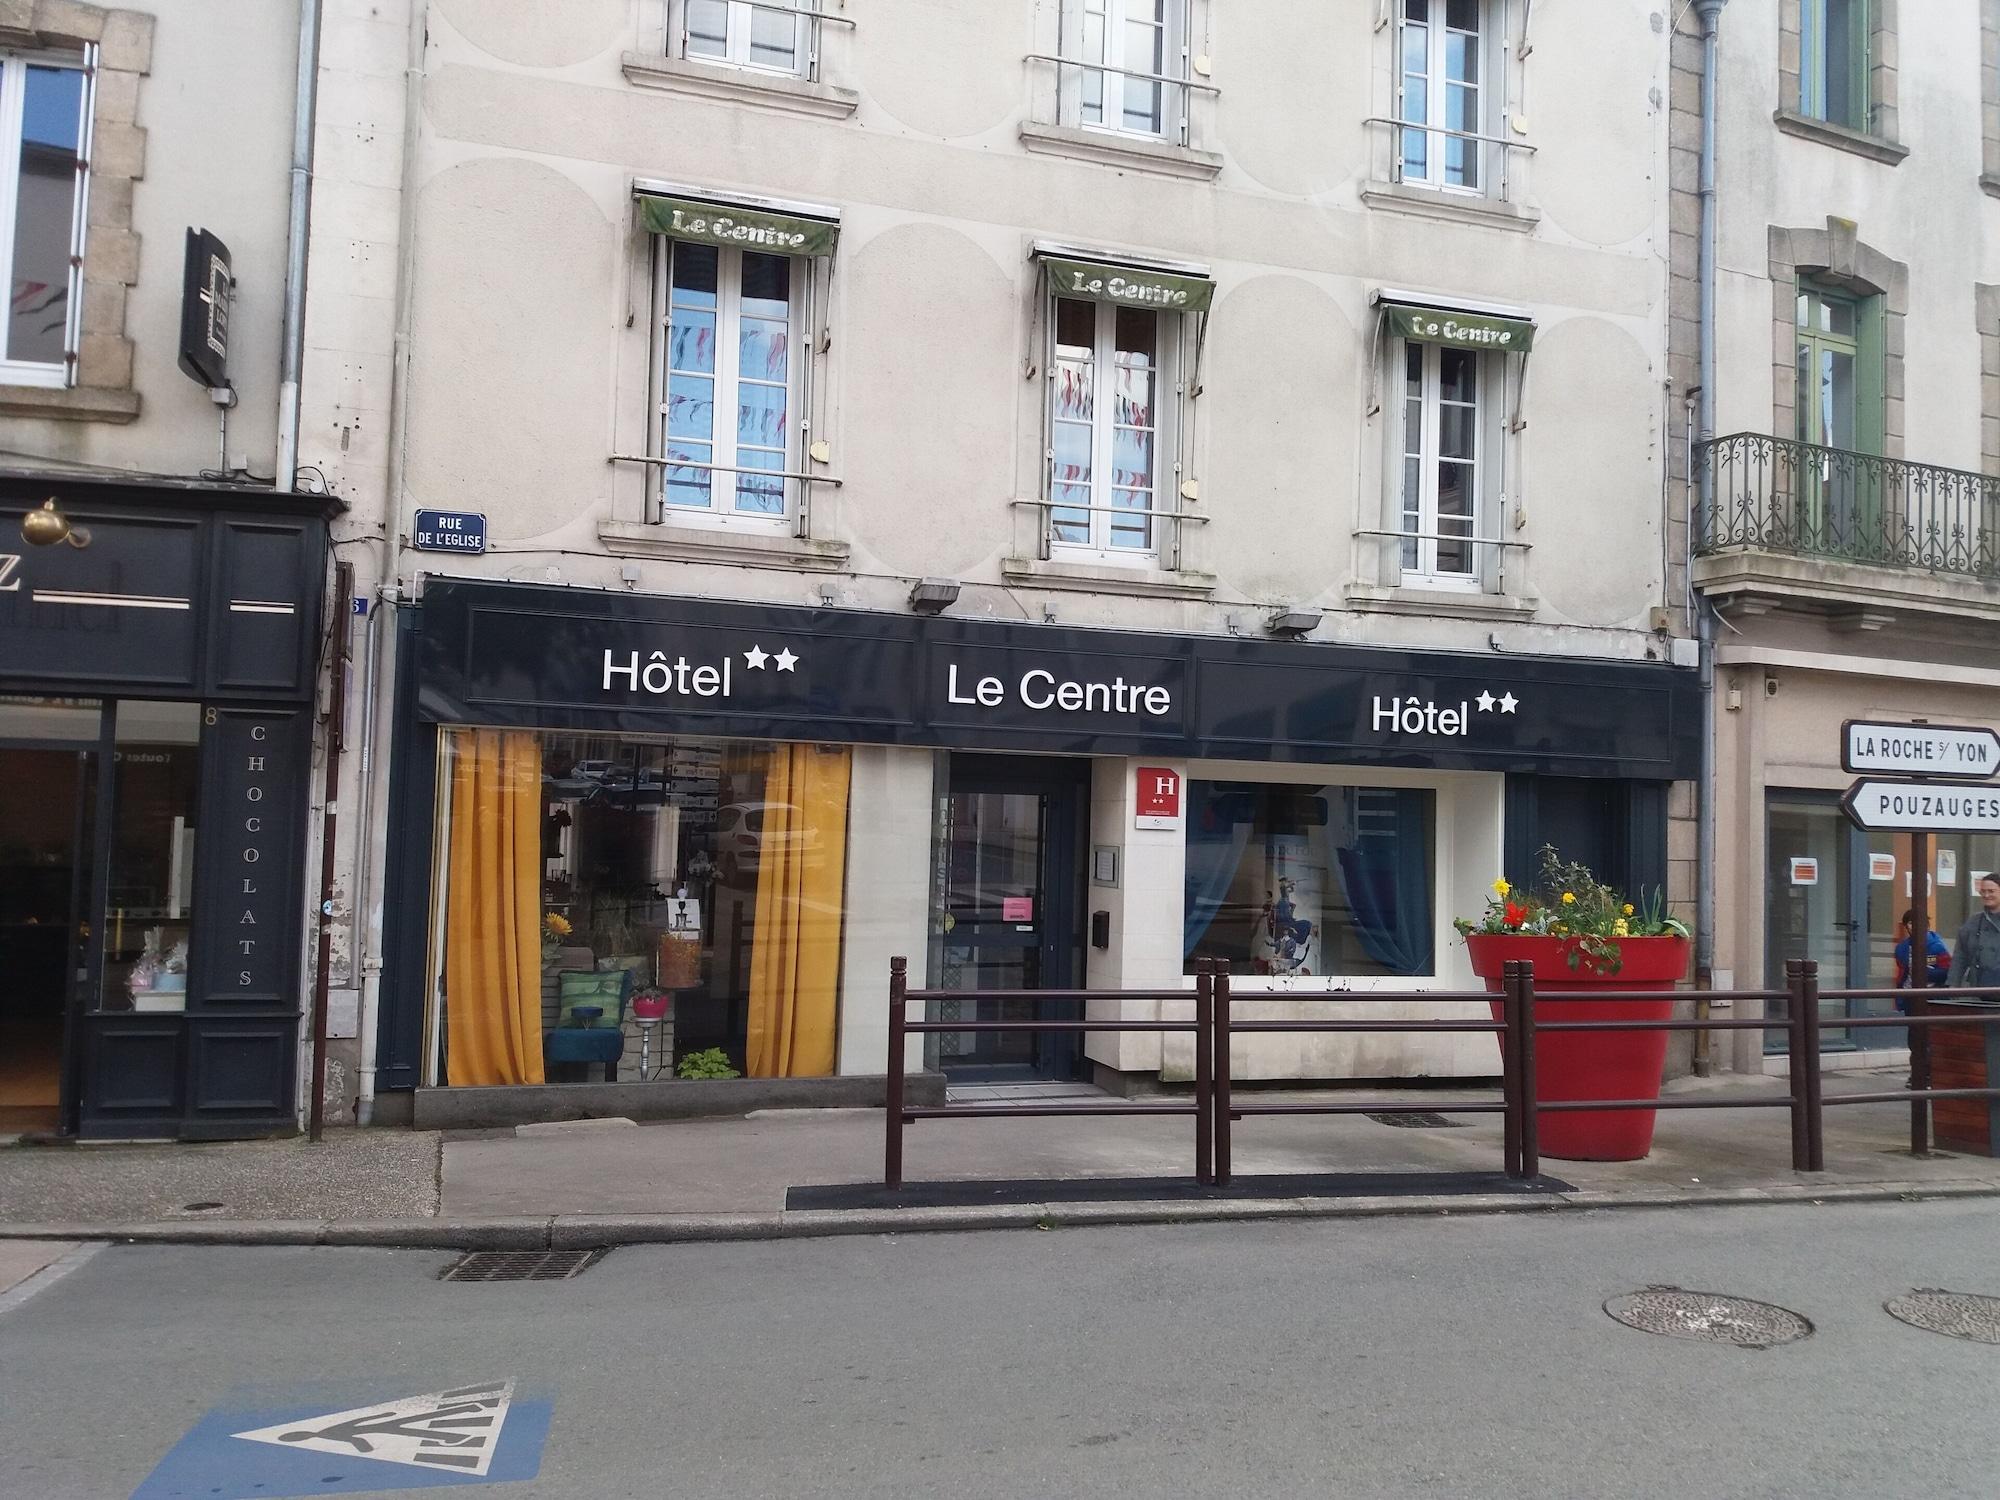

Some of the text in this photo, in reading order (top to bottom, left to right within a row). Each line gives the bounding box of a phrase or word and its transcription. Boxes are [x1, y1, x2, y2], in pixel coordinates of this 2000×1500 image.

[671, 210, 805, 248] Le Centre
[1072, 271, 1188, 304] Le Centre
[1443, 320, 1512, 344] Centre
[438, 516, 462, 530] RUE
[418, 531, 481, 547] DE L'EGLISE
[603, 649, 731, 697] Hôtel
[948, 664, 1171, 715] Le Centre
[205, 707, 217, 725] 8
[1372, 696, 1468, 736] Hôtel
[1857, 737, 1875, 756] LA
[1881, 738, 1933, 759] ROCHE
[1956, 742, 1987, 762] YON
[1155, 776, 1176, 796] H
[1880, 795, 1999, 818] POUZAUGES
[239, 726, 266, 986] CHOCOLATS
